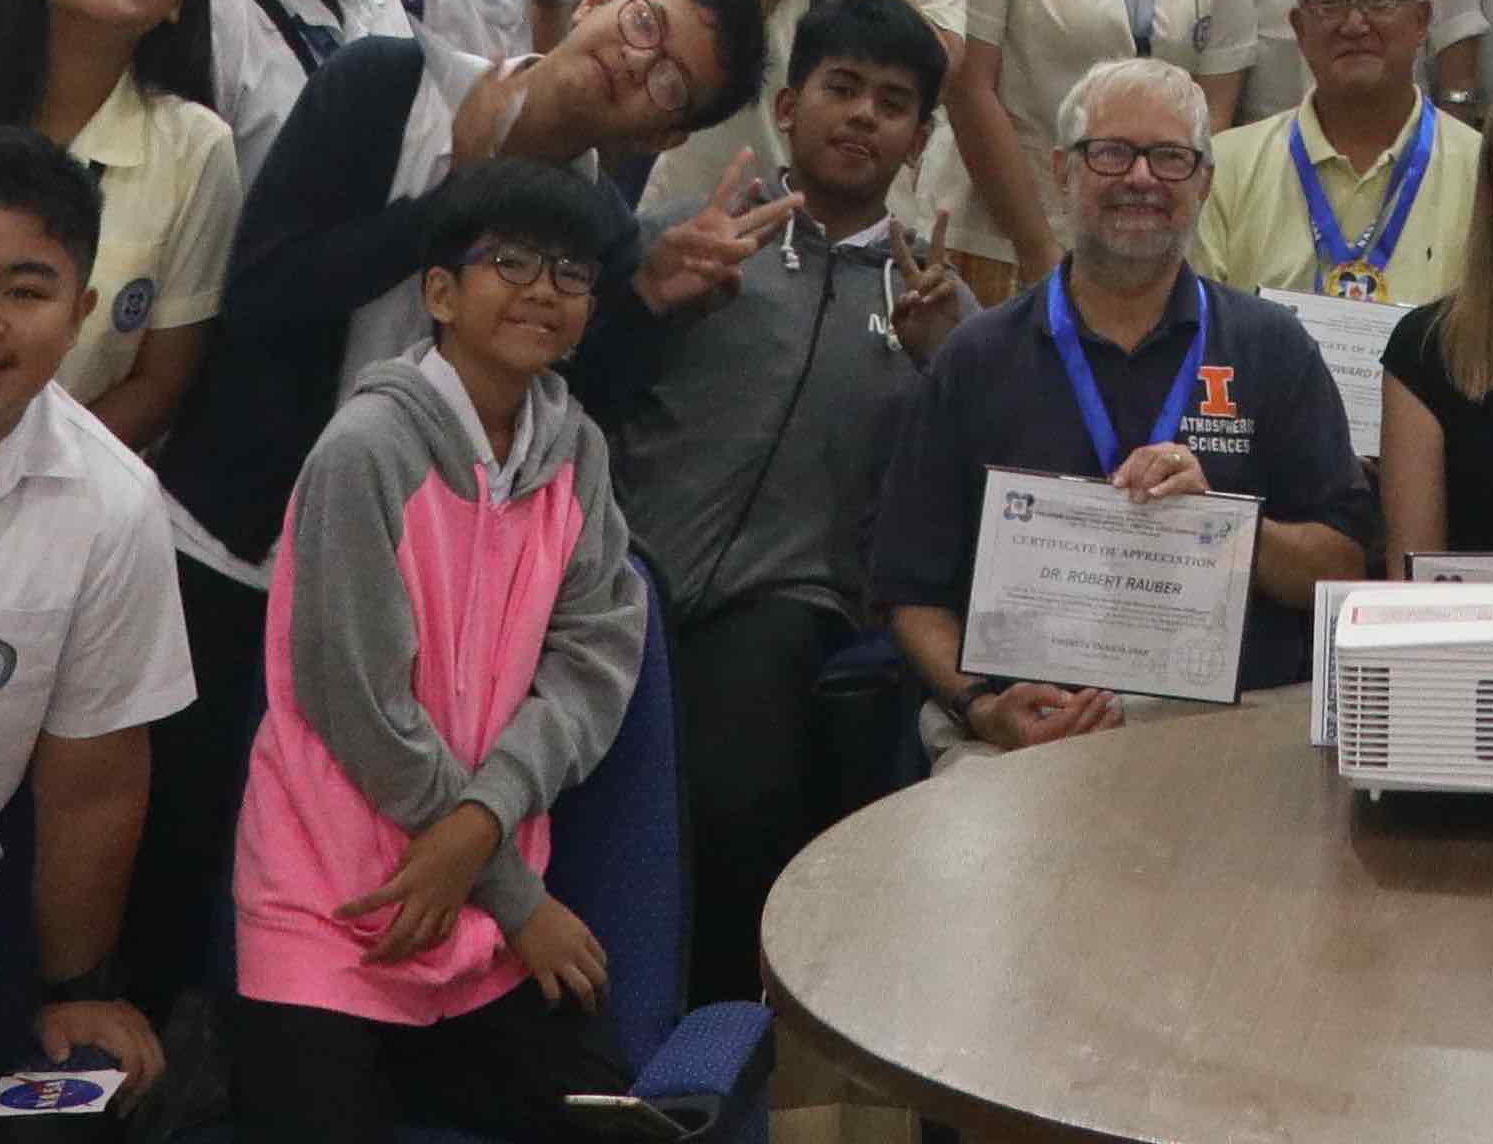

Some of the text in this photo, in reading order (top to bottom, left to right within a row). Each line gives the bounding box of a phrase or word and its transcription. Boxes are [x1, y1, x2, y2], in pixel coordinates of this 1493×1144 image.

[1187, 434, 1251, 454] SCIENCES
[1012, 535, 1218, 568] CERTIFICATE OF APPRECIATION
[1066, 570, 1122, 590] ROBERT
[1124, 576, 1183, 595] RAUBER
